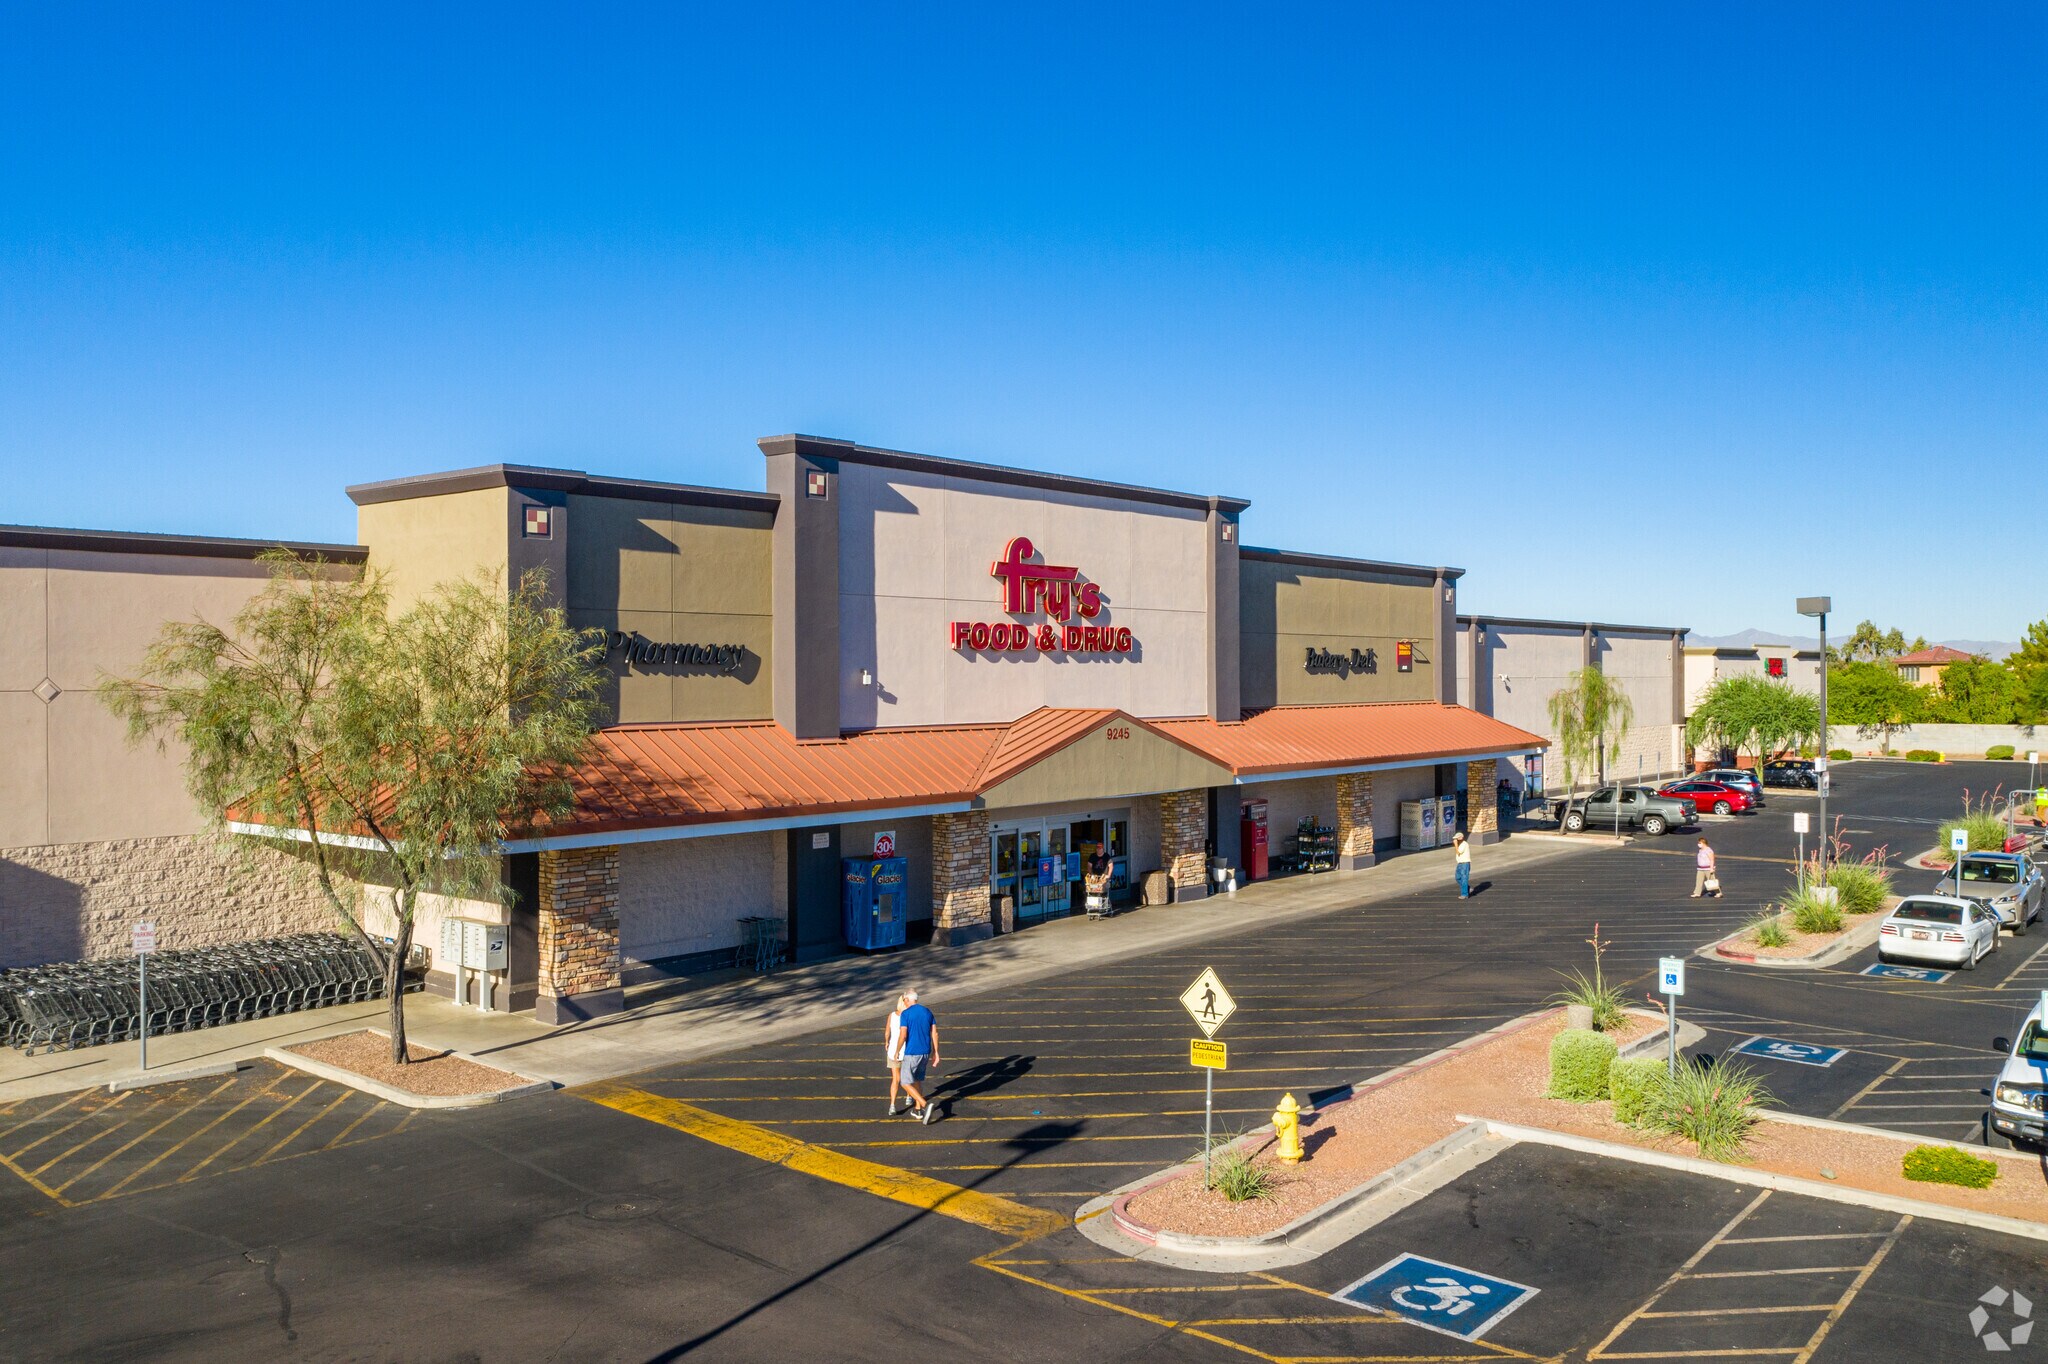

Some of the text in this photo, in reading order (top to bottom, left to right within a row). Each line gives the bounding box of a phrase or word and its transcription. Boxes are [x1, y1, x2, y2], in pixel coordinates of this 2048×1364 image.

[990, 536, 1102, 623] fry's
[951, 621, 1132, 653] FOOD & DRUG
[600, 630, 745, 672] Pharmacy
[1106, 727, 1129, 740] 9245
[876, 874, 903, 885] Glacier
[1194, 1042, 1223, 1052] CAUTION
[1192, 1052, 1225, 1062] PEDESTRIANS
